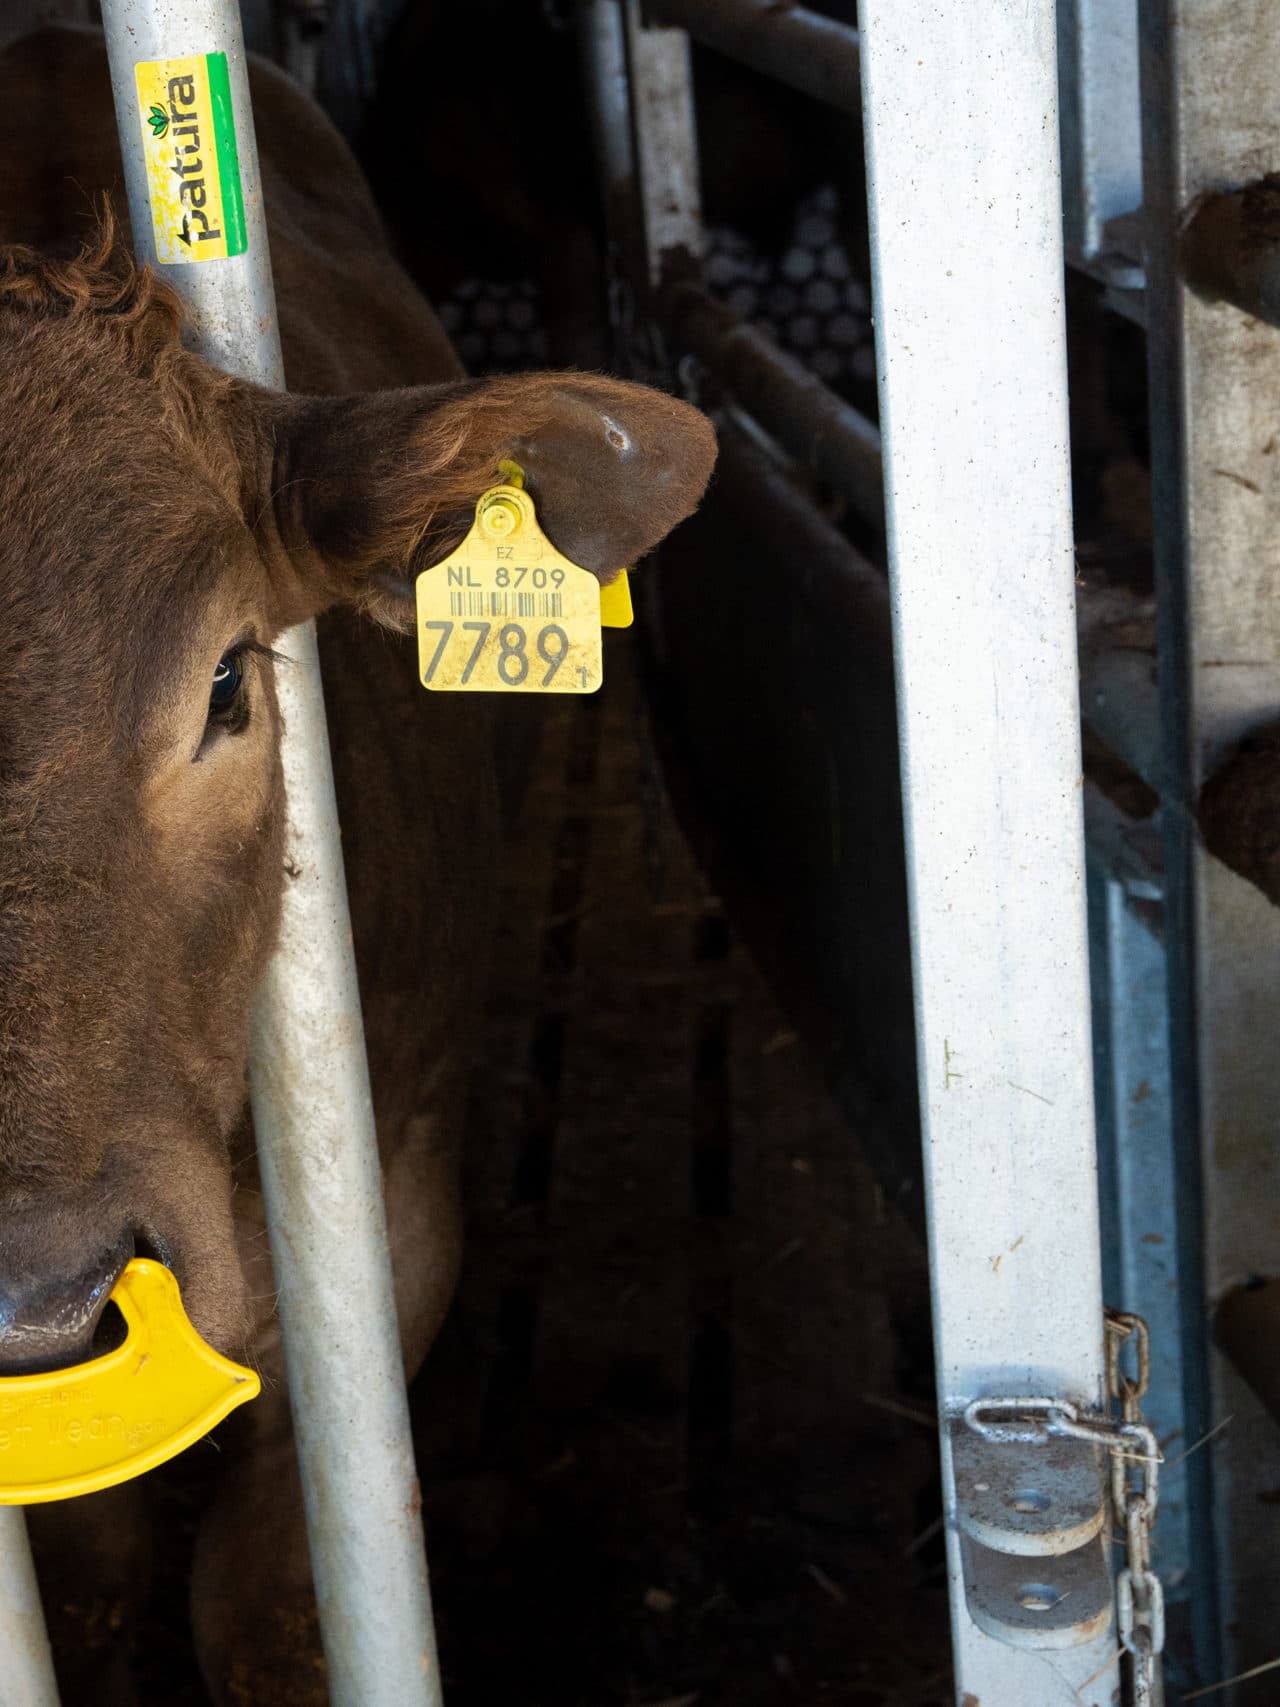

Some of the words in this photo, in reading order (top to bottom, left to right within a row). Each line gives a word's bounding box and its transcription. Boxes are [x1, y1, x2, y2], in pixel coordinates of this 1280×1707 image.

[168, 74, 221, 247] patura
[496, 546, 514, 560] EZ
[447, 566, 482, 588] NL
[495, 566, 566, 590] 8709
[424, 620, 570, 687] 7789
[576, 665, 588, 689] 1
